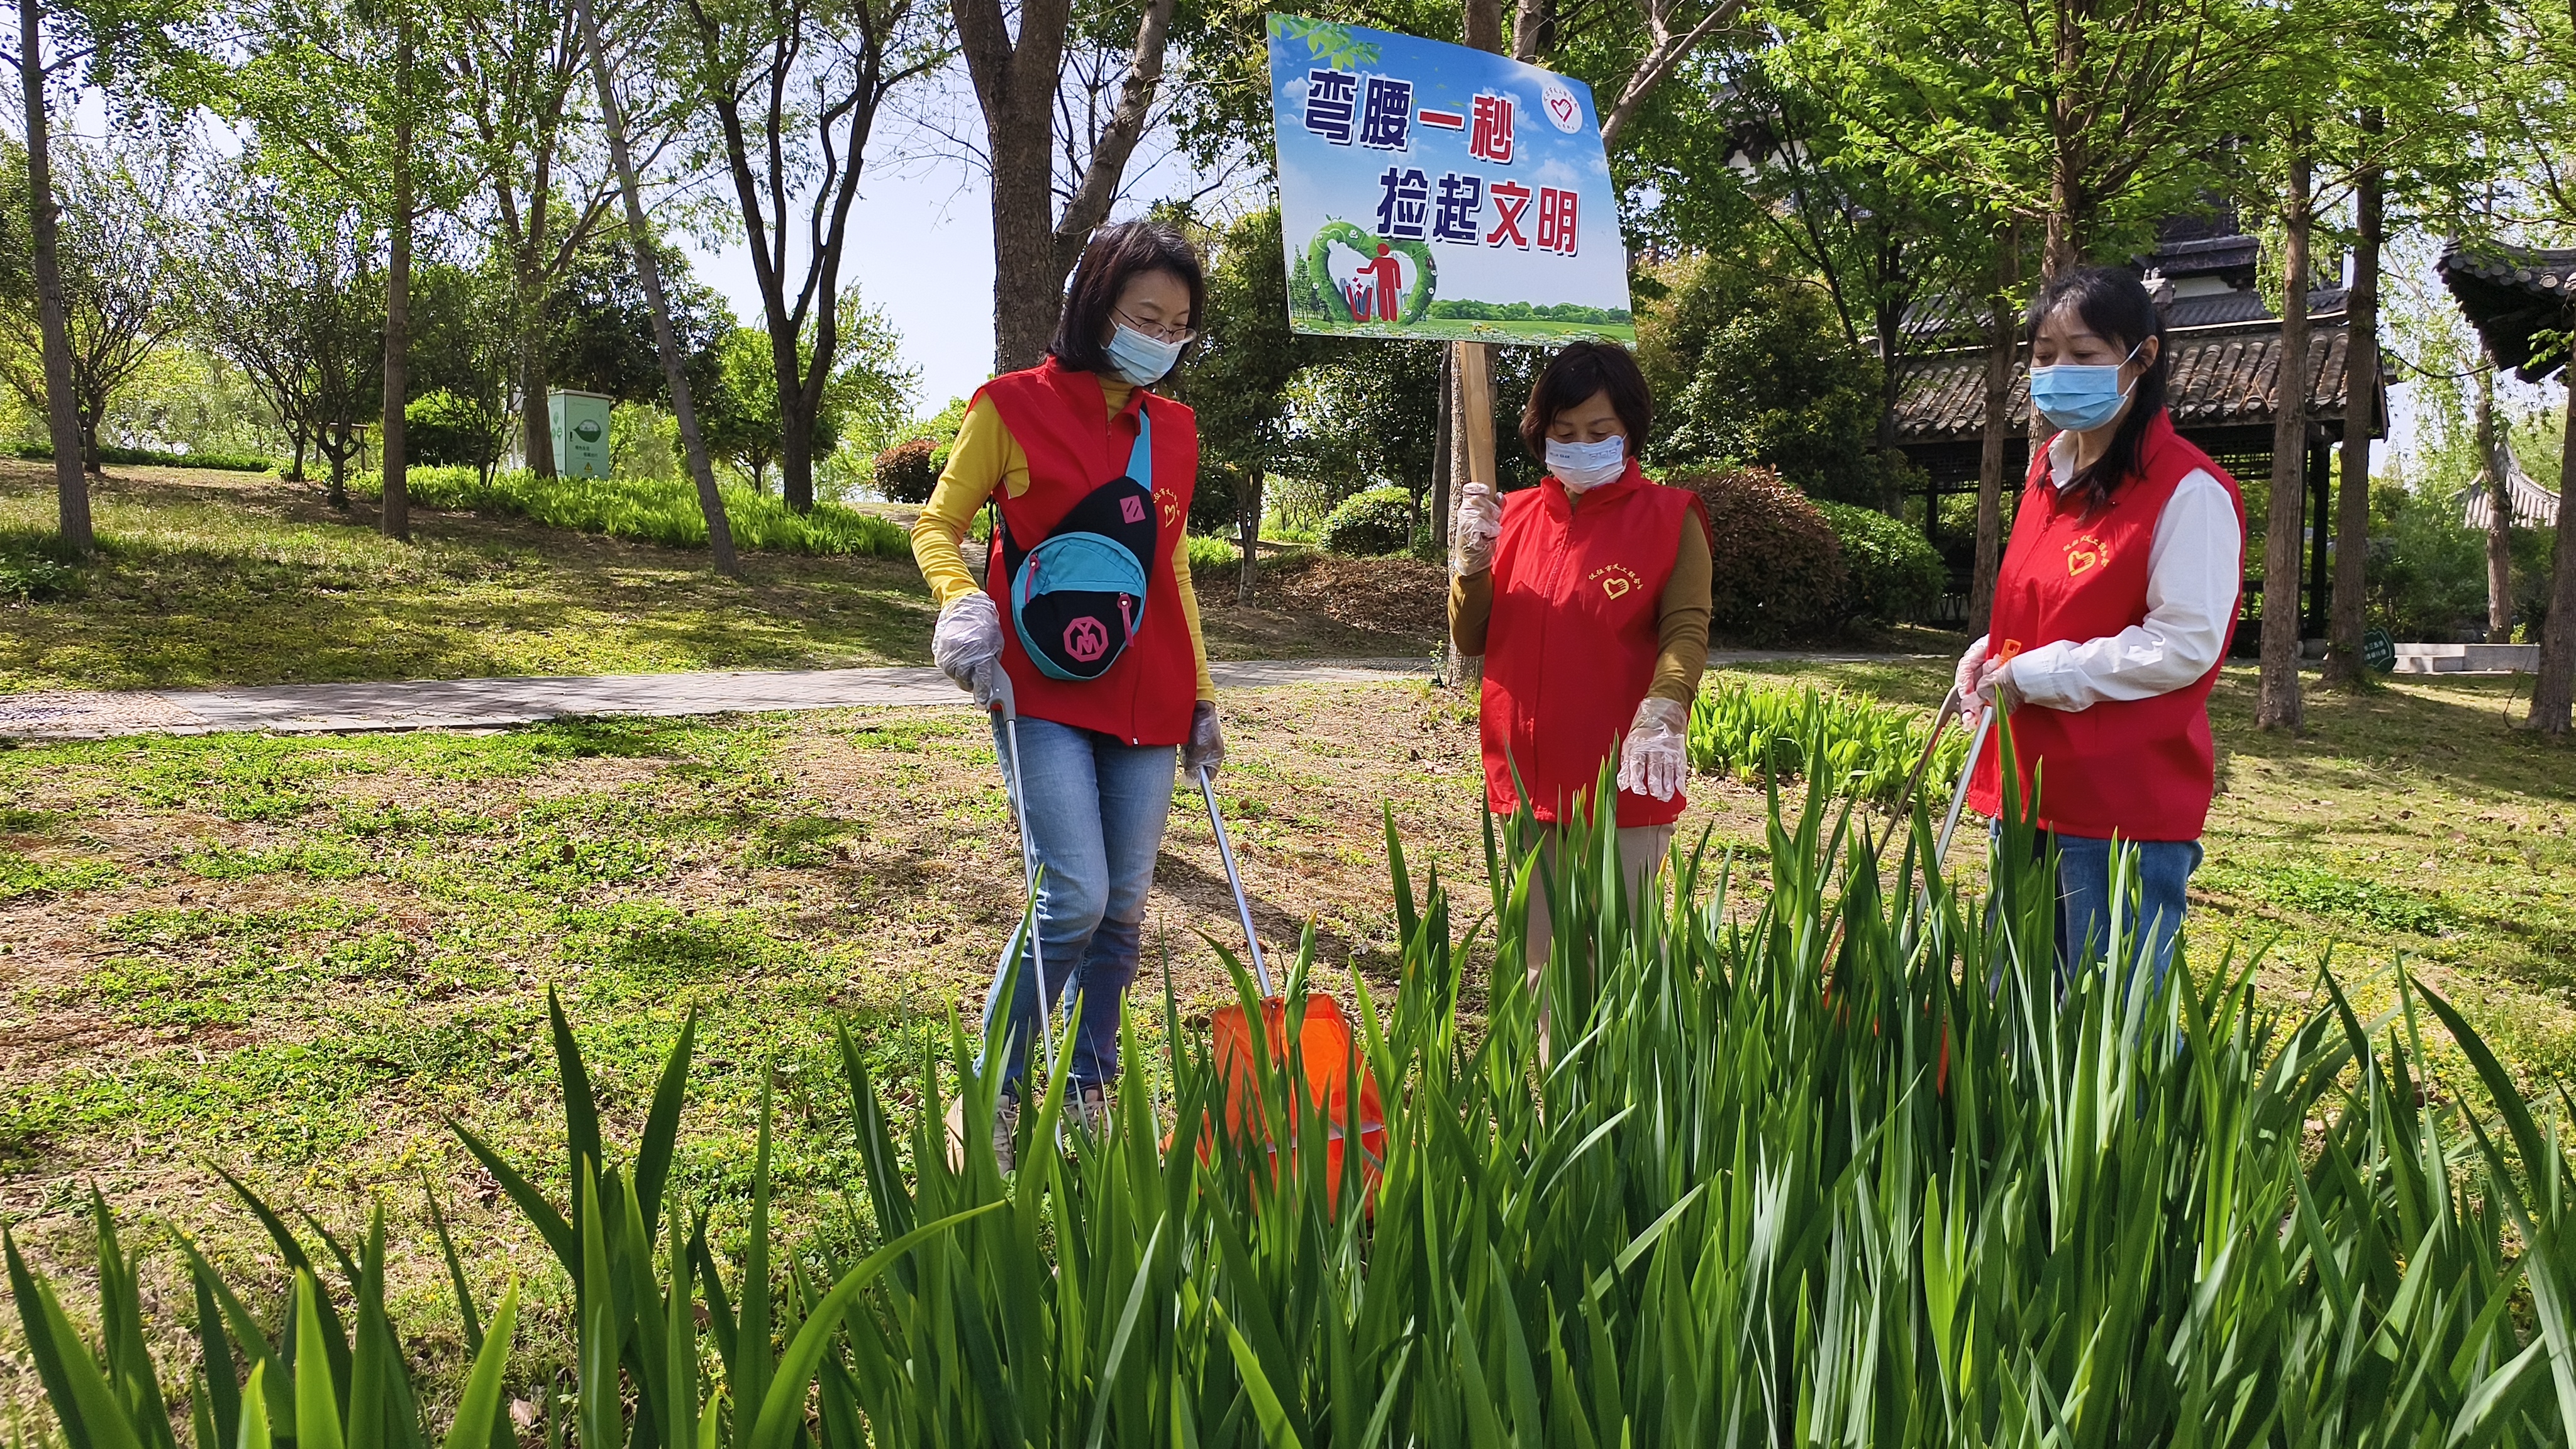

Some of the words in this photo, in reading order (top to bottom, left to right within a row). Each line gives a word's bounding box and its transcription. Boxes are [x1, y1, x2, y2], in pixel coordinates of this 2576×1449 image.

[1305, 70, 1514, 163] 弯腰一秒
[1376, 167, 1579, 254] 捡起文明
